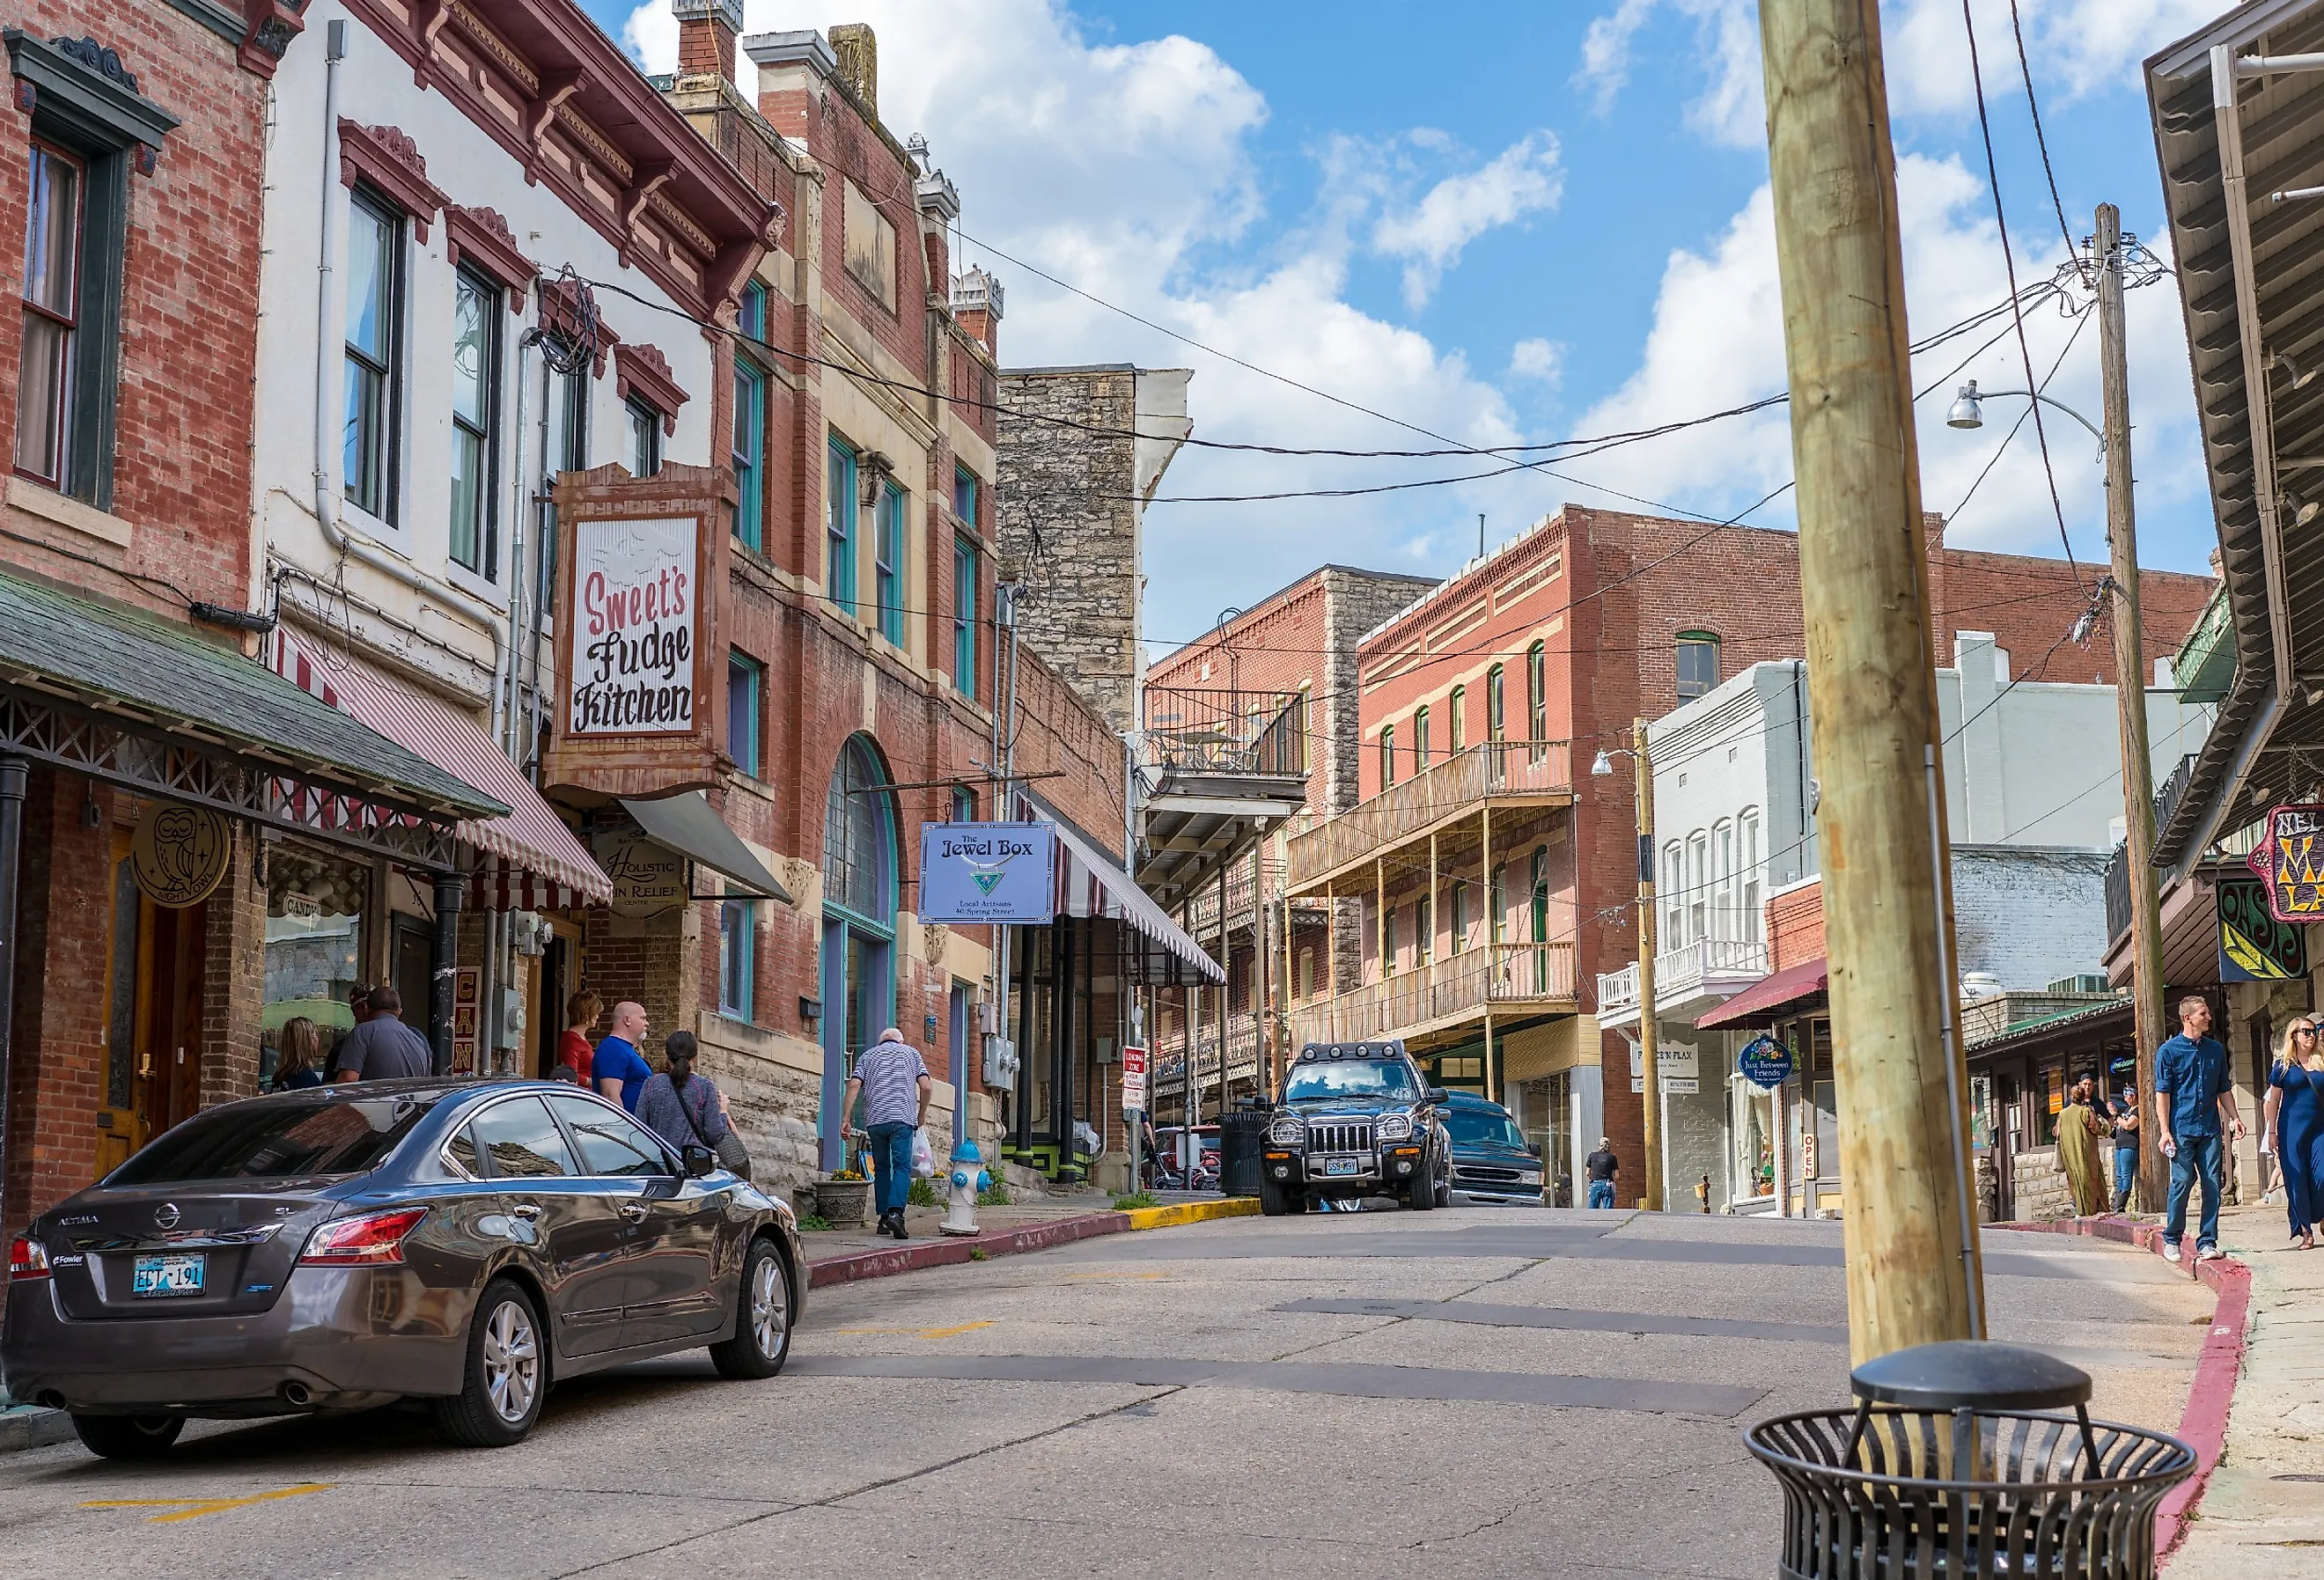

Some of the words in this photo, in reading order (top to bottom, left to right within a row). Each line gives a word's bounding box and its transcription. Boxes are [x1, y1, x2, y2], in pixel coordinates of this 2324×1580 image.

[585, 565, 688, 636] Sweet's
[586, 621, 689, 683] Fudge
[574, 680, 691, 732] Kitchen
[941, 840, 992, 858] Jewel
[997, 840, 1033, 856] Box
[192, 871, 214, 893] OWL
[158, 891, 185, 901] NIGHT
[632, 886, 679, 898] RELIEF
[1125, 1053, 1144, 1062] LOADING
[1673, 1051, 1692, 1060] FLAX
[1129, 1062, 1140, 1072] ZONE
[1745, 1060, 1758, 1069] Just
[1760, 1060, 1789, 1069] Between
[1805, 1135, 1813, 1177] OPEN
[275, 1207, 297, 1216] SL
[59, 1254, 84, 1263] Fowler
